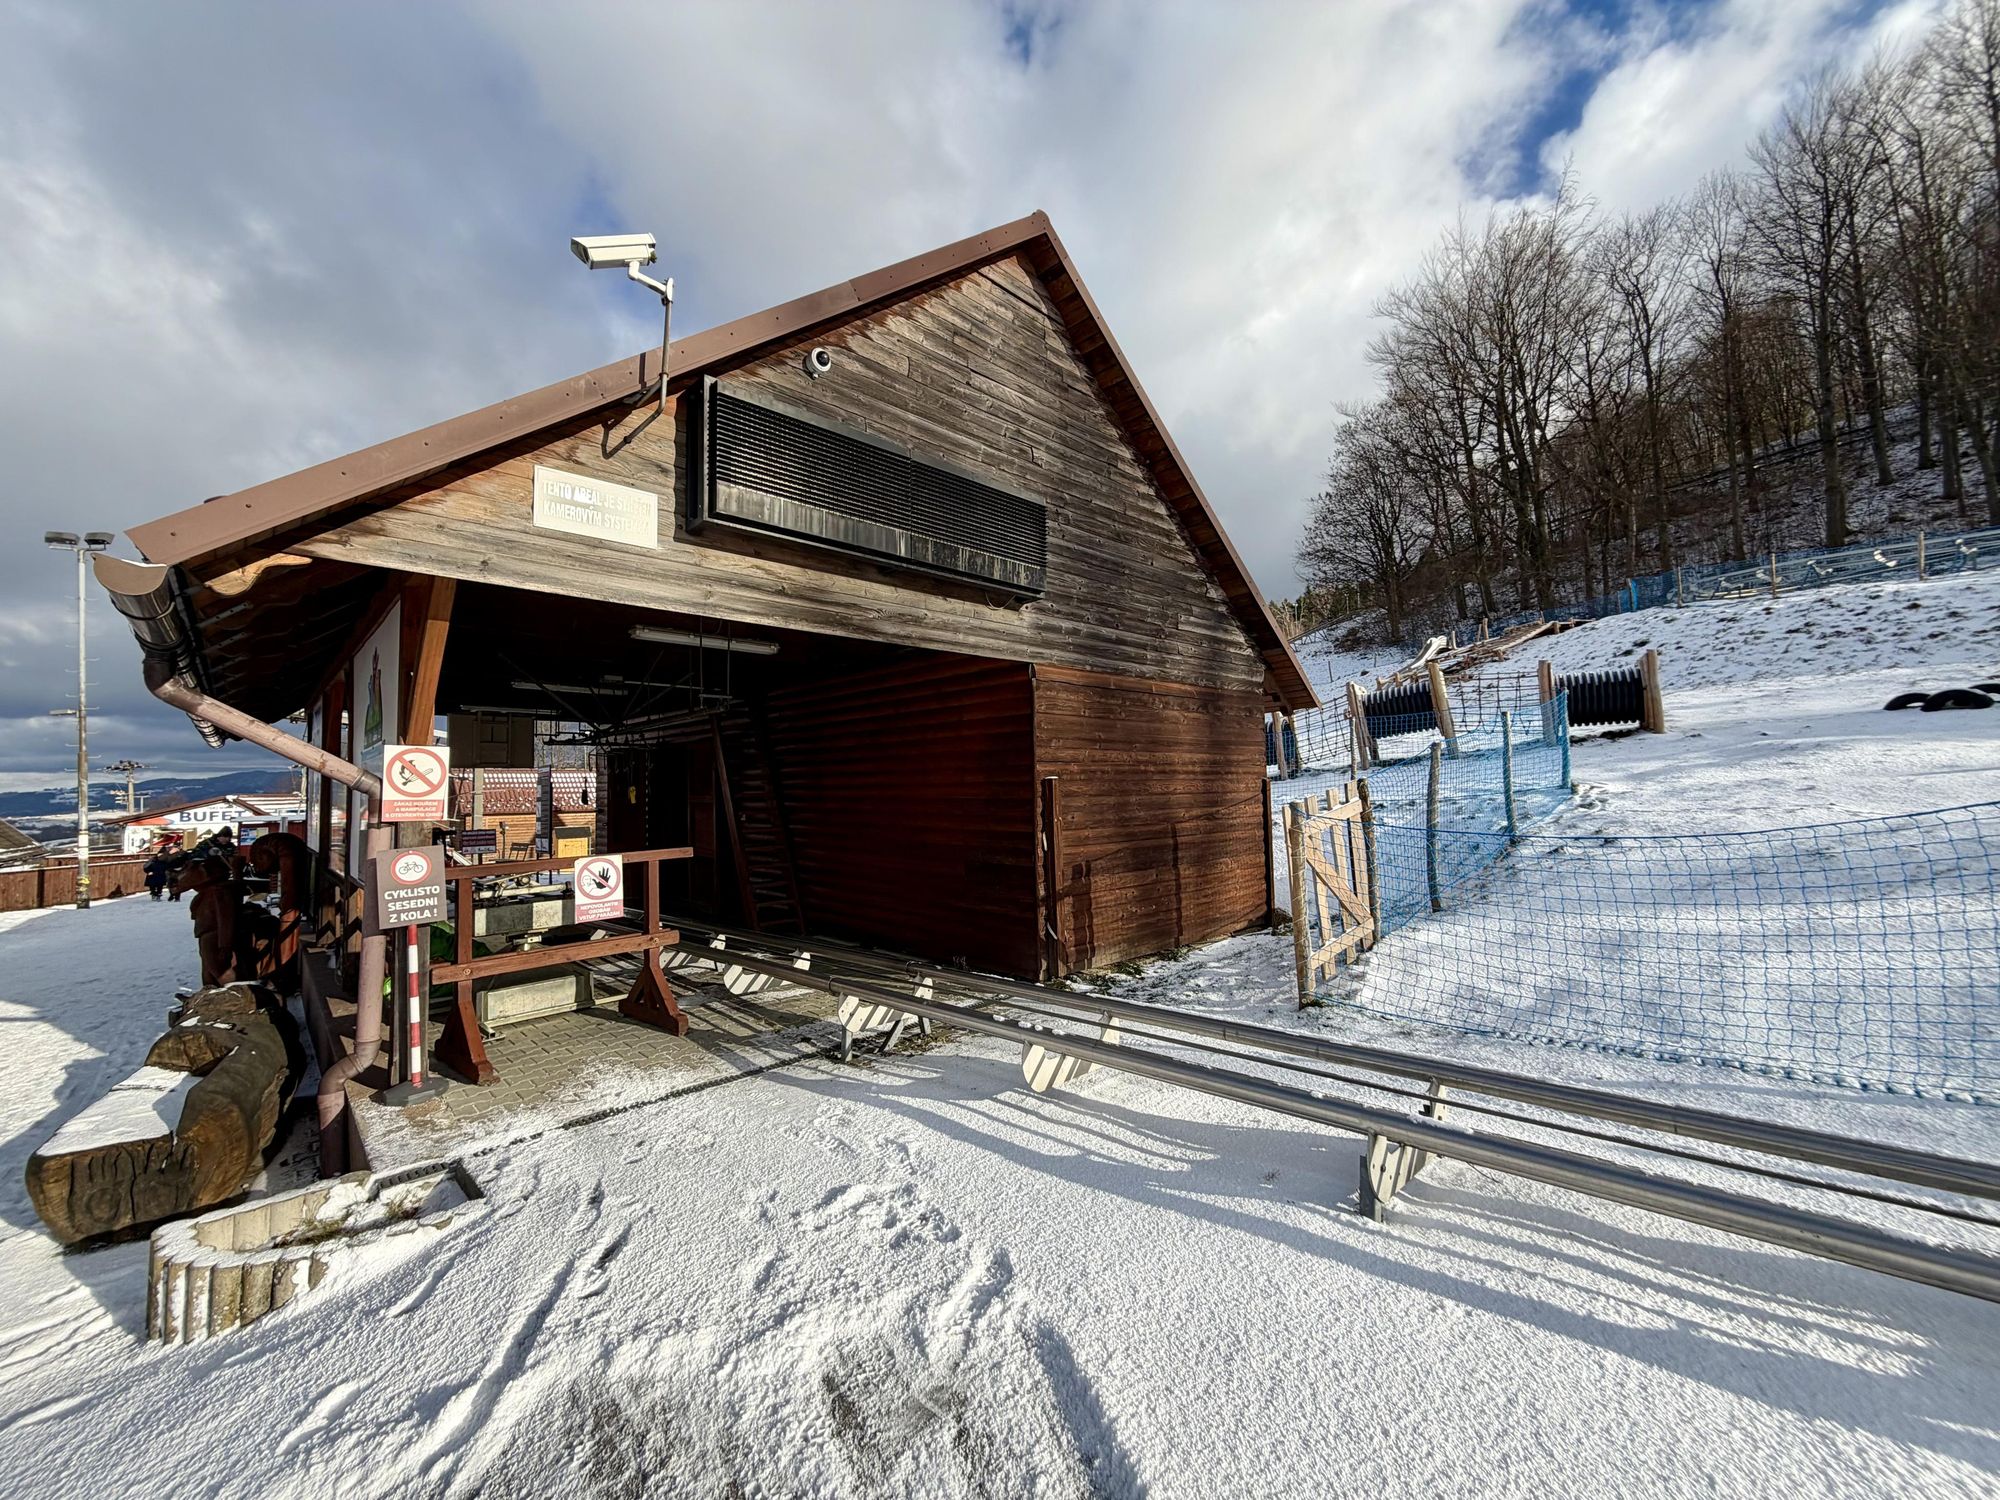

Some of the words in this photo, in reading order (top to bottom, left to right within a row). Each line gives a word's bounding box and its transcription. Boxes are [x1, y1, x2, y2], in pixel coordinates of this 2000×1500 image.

[543, 480, 572, 500] TENTO
[603, 494, 615, 509] JE
[543, 499, 602, 527] KAMEROVÝM
[604, 513, 649, 536] SYST
[179, 810, 246, 822] BUFET
[384, 885, 440, 900] CYKLISTO
[387, 896, 438, 911] SESEDNI
[389, 913, 398, 923] Z
[400, 909, 432, 922] KOLA
